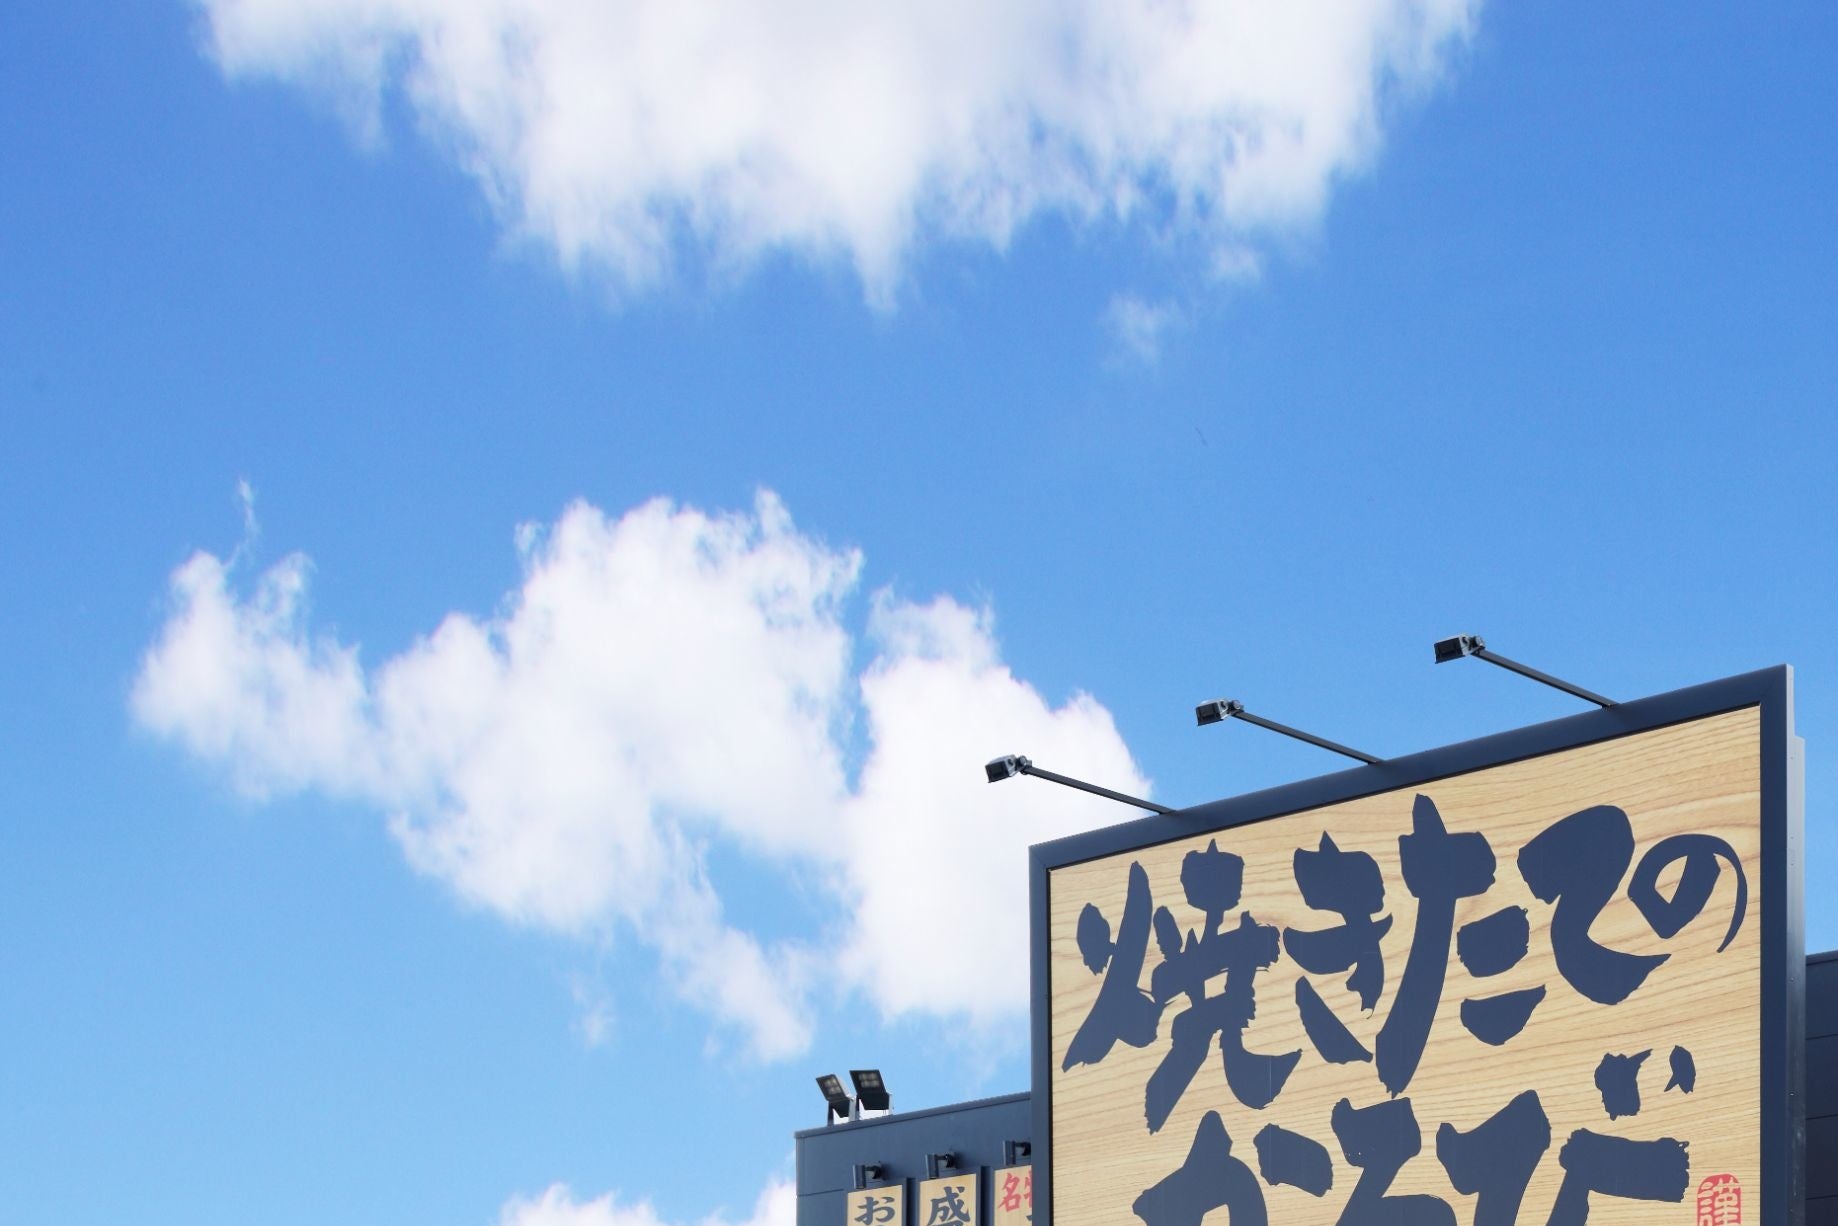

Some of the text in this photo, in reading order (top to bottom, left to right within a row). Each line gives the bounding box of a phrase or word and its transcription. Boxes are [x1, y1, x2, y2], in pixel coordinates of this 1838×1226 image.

[1062, 793, 1748, 1134] 焼きたての
